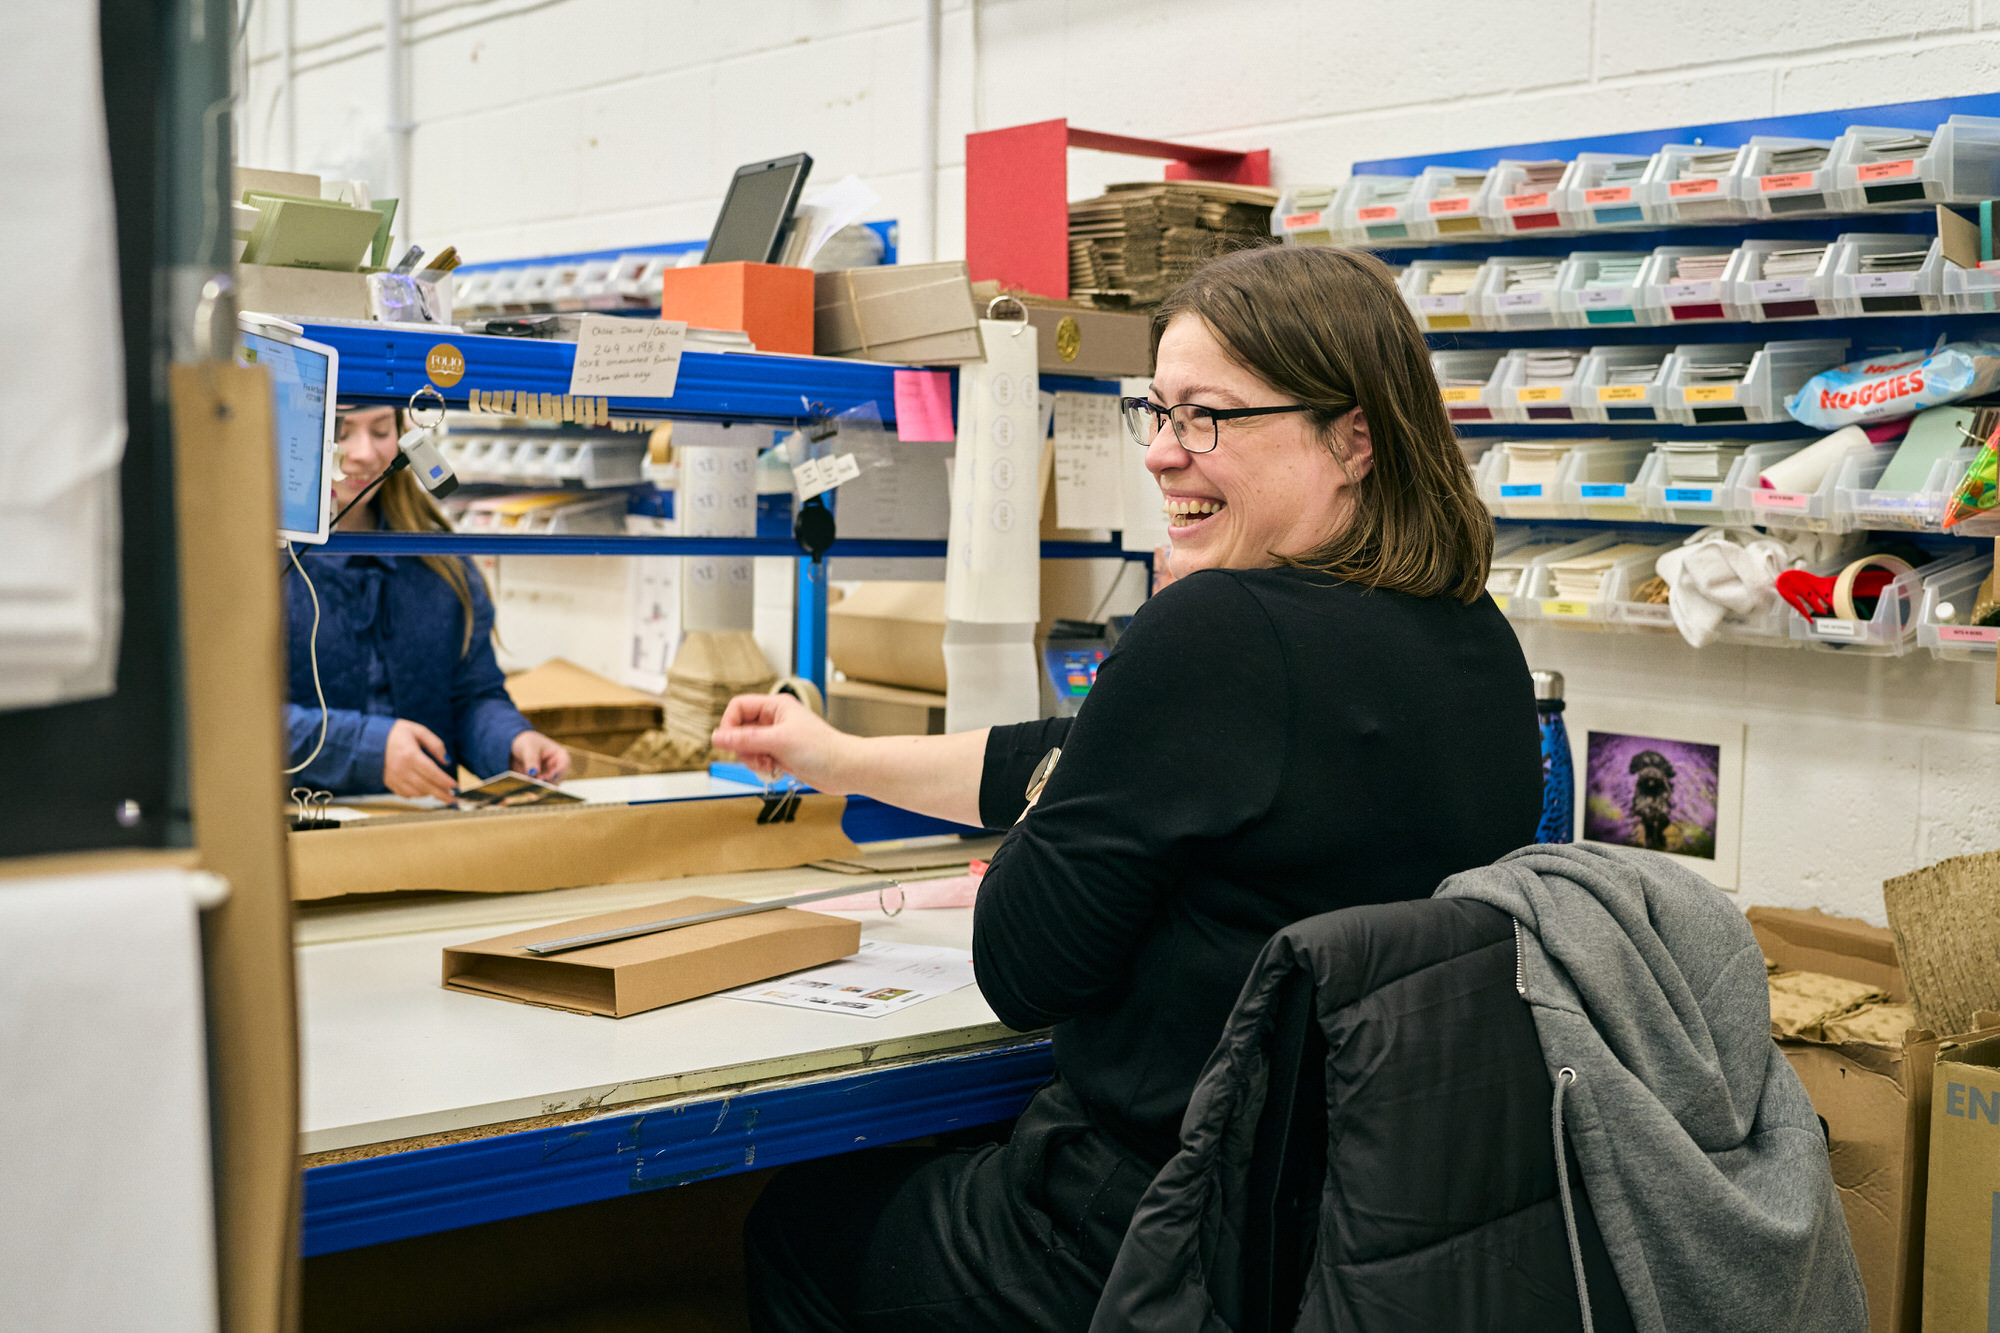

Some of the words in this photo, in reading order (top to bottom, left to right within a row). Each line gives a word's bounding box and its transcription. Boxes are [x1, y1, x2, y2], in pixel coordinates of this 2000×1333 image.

[431, 354, 462, 367] FOLIO
[634, 371, 651, 383] edge
[1819, 369, 1925, 411] HUGGIES
[1946, 1081, 2000, 1126] EN
